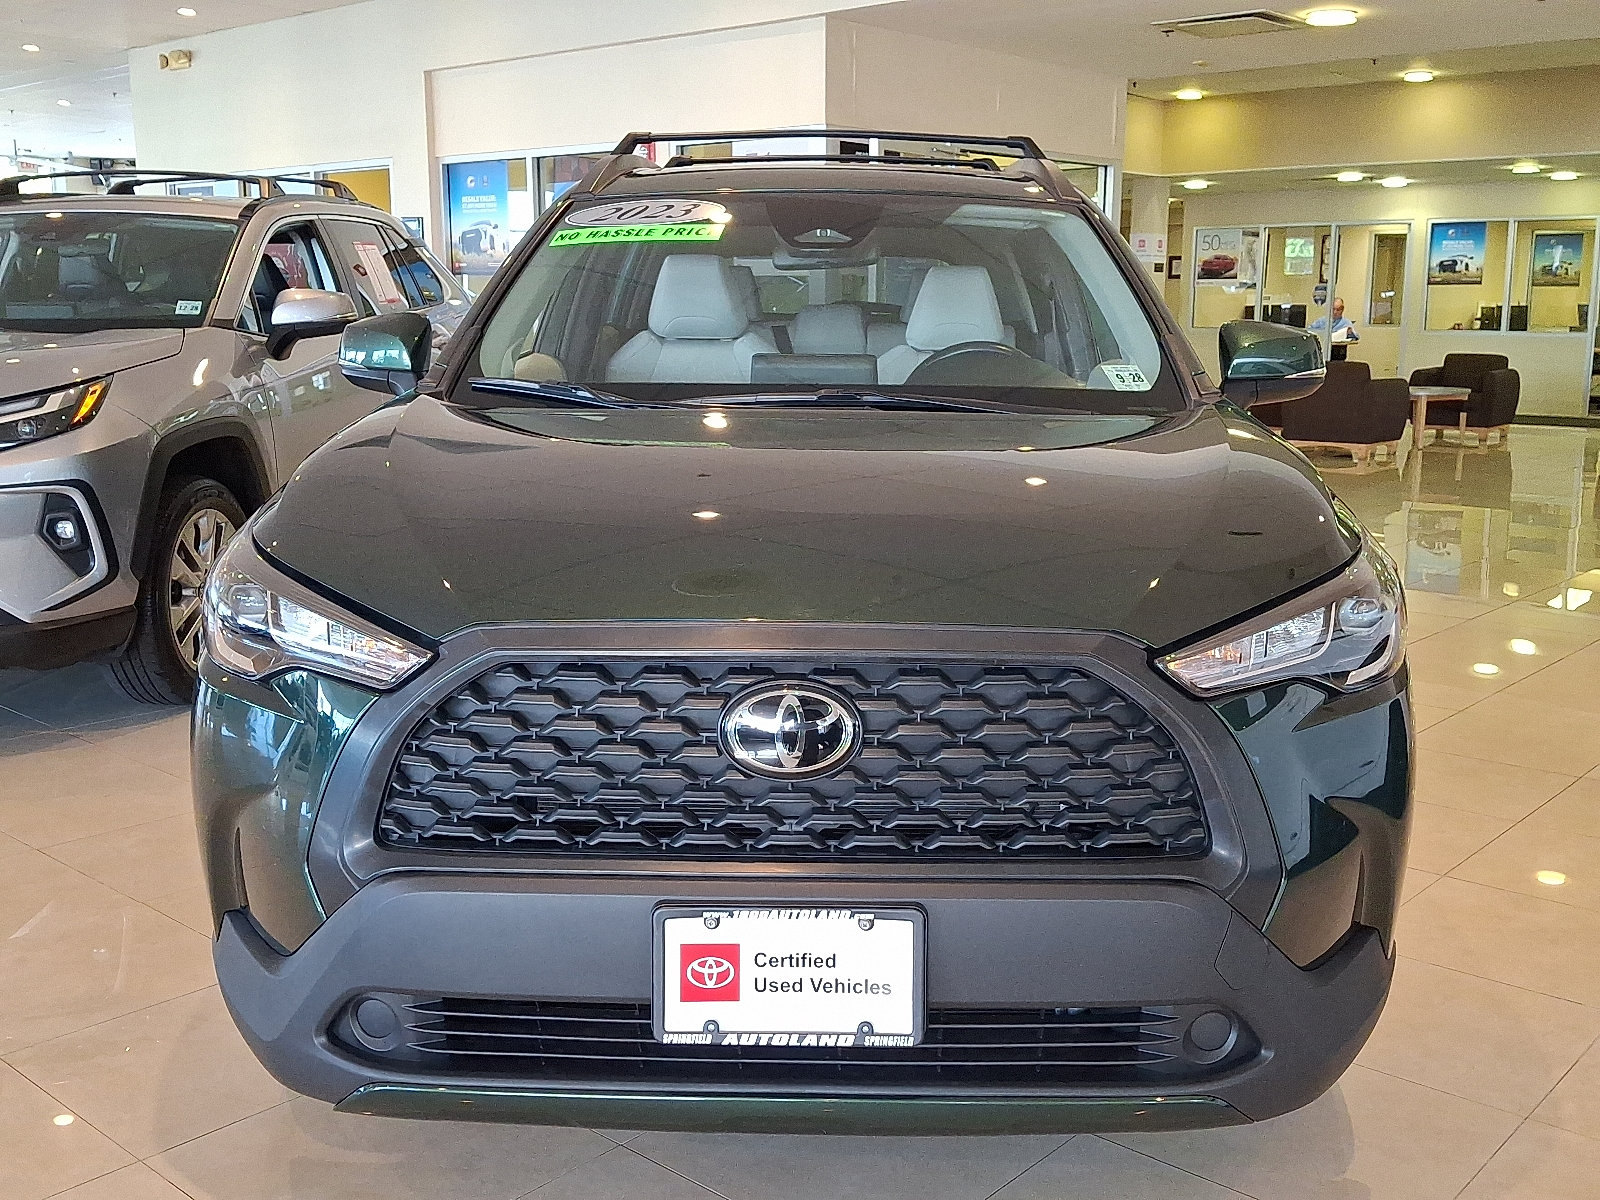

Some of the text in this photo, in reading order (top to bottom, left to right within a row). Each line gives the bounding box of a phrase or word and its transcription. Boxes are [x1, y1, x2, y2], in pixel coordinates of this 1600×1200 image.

[588, 203, 701, 222] 2023
[554, 226, 714, 242] NO HASSLE PRIC
[1201, 234, 1221, 251] 50
[1115, 372, 1145, 383] 9 28
[754, 952, 836, 968] Certified
[754, 977, 892, 995] Used Vehicles
[662, 1033, 713, 1045] SPRINGFIELD
[721, 1034, 856, 1047] AUTOLAND
[863, 1036, 915, 1047] SPRINGFIELD
